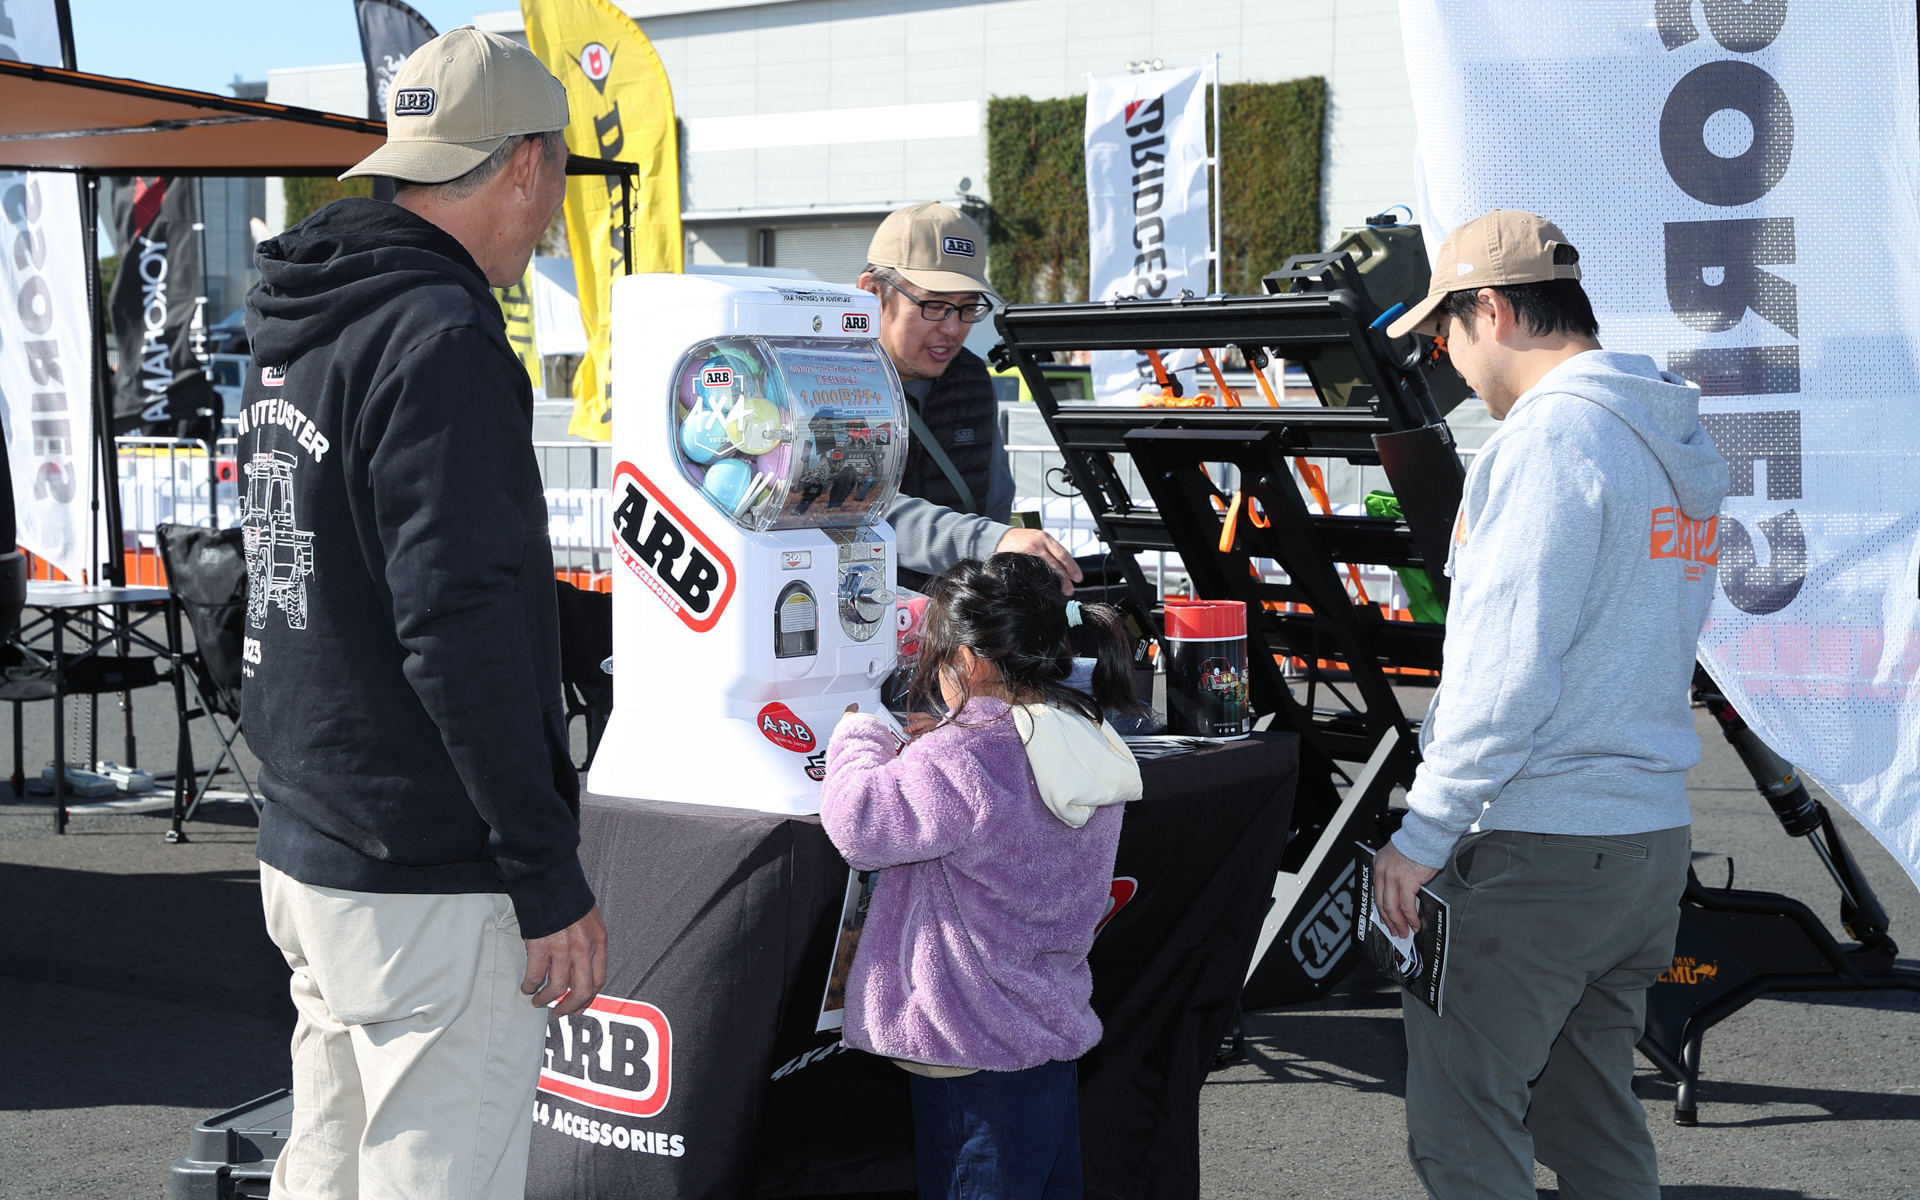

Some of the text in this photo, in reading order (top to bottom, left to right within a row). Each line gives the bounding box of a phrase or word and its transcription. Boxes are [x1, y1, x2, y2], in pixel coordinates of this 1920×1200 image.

[398, 92, 430, 109] ARB
[947, 239, 972, 253] ARB
[844, 316, 868, 329] ARB
[706, 372, 730, 383] ARB
[800, 388, 883, 409] 1,000円ガチャ
[613, 482, 719, 613] ARB
[628, 558, 681, 613] ACCESSORIES
[243, 635, 262, 665] 023
[762, 713, 813, 743] ARB
[1362, 864, 1370, 889] RACK
[1360, 890, 1369, 916] BASE
[1674, 956, 1696, 967] MAN
[541, 1011, 651, 1093] ARB
[551, 1108, 686, 1158] ACCESSORIES
